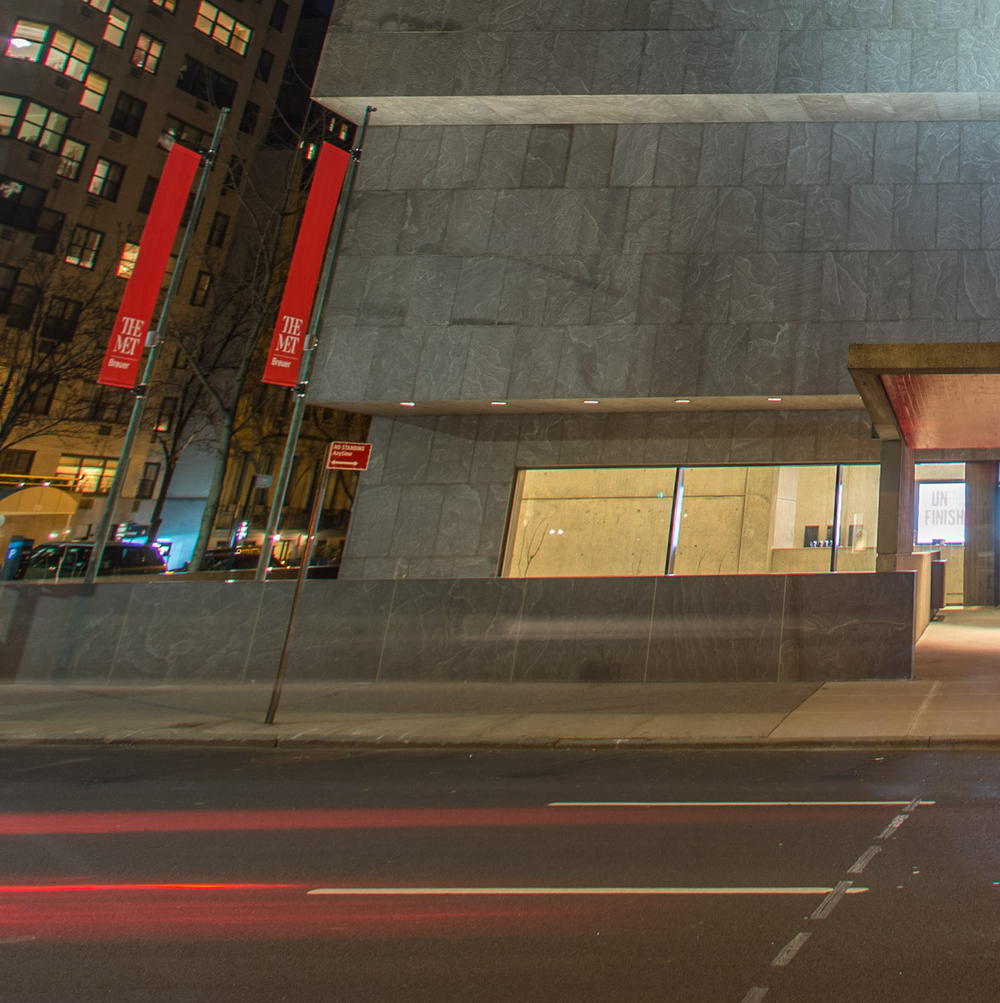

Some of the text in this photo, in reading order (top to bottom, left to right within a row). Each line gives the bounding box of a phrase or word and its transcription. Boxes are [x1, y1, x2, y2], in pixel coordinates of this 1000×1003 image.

[121, 316, 145, 337] THE
[282, 315, 303, 336] THE
[113, 335, 140, 355] MET
[275, 333, 300, 354] MET
[108, 358, 130, 369] Breuer
[271, 356, 291, 368] Breuer
[931, 490, 948, 507] UN
[8, 548, 17, 558] P
